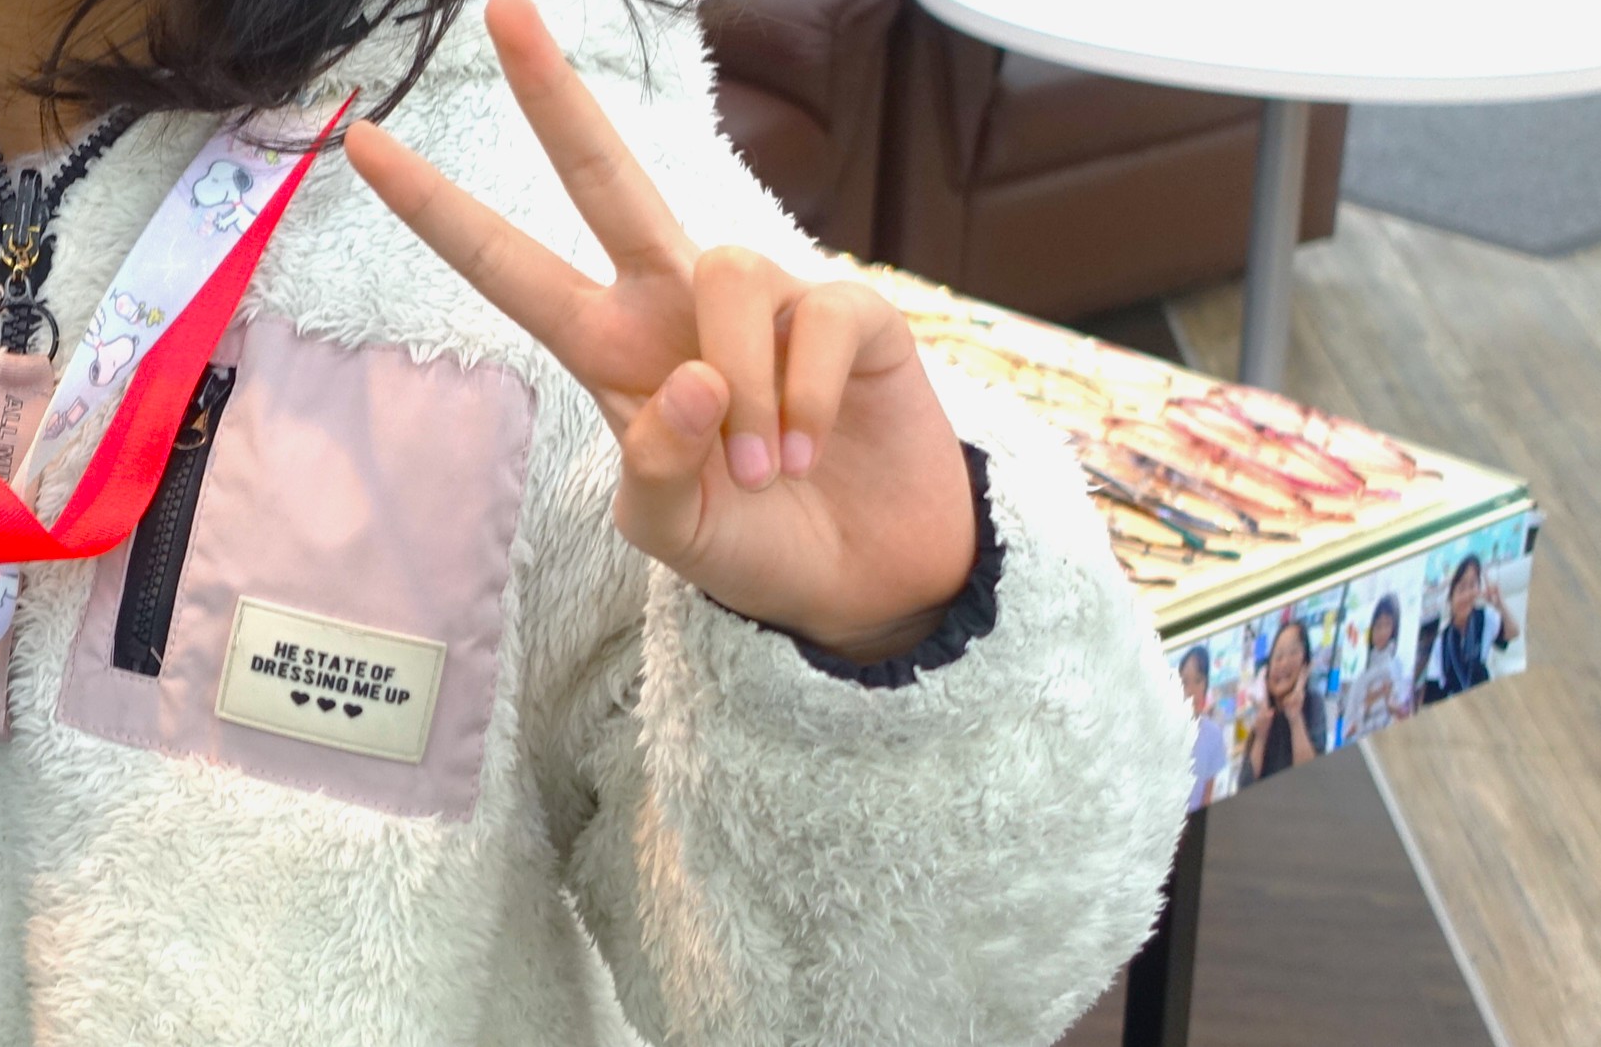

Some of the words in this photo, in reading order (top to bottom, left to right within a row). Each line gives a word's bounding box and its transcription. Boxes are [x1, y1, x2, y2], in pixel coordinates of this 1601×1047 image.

[274, 640, 299, 662] HE
[303, 648, 367, 678] STATE
[370, 664, 395, 682] OF
[352, 680, 382, 701] ME
[385, 687, 410, 705] UP
